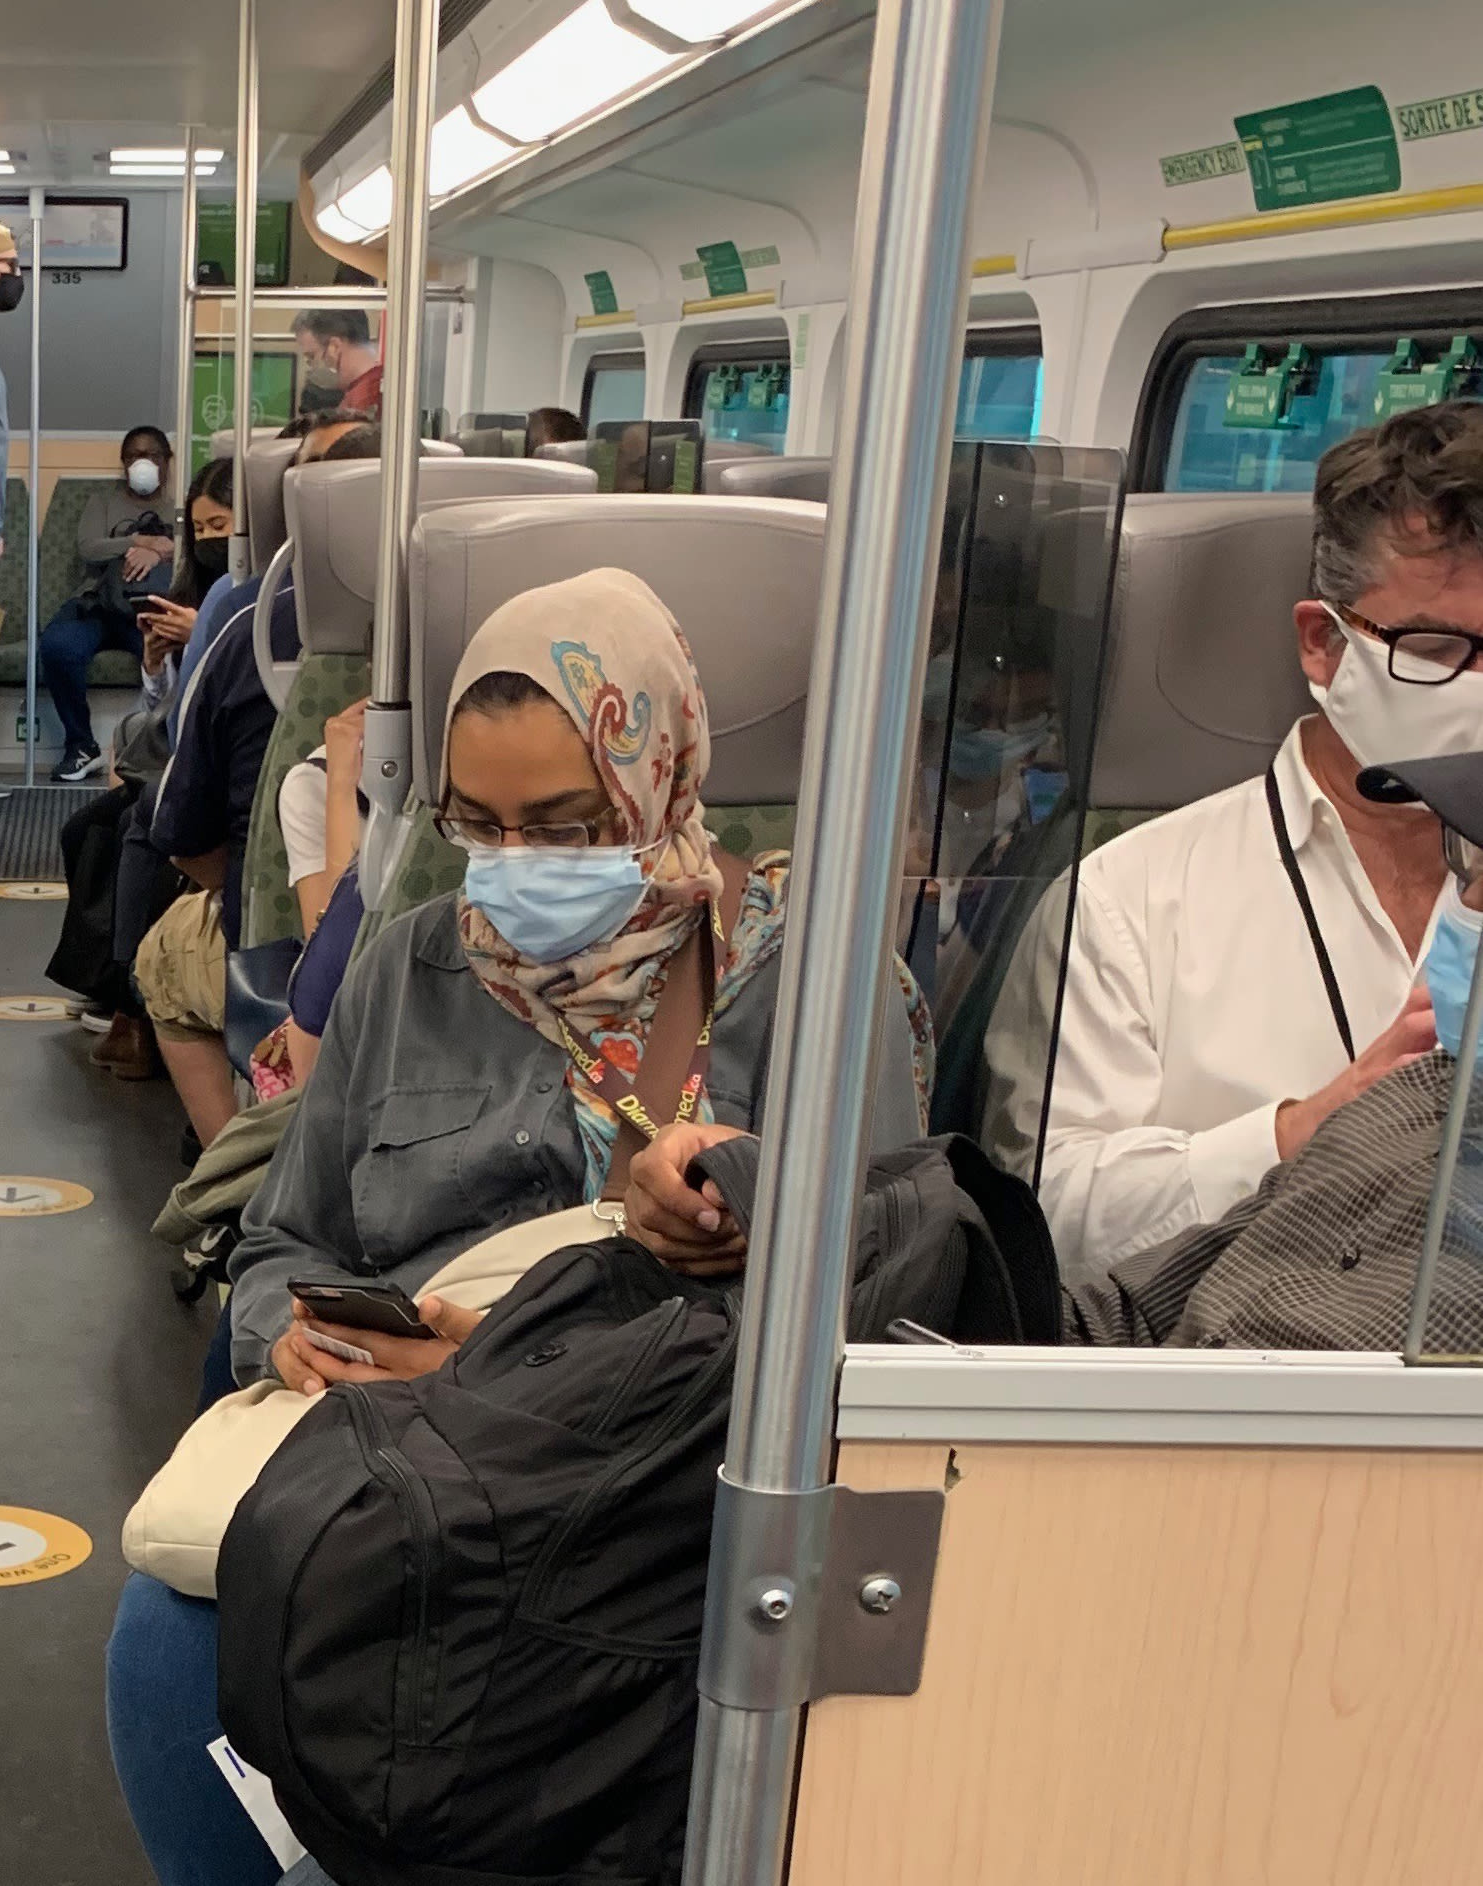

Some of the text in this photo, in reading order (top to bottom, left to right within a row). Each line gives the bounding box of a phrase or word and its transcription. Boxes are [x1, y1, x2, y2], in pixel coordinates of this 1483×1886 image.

[1400, 103, 1451, 136] SORTIE
[1452, 98, 1473, 127] DE
[52, 271, 81, 285] 335
[35, 1552, 72, 1571] One
